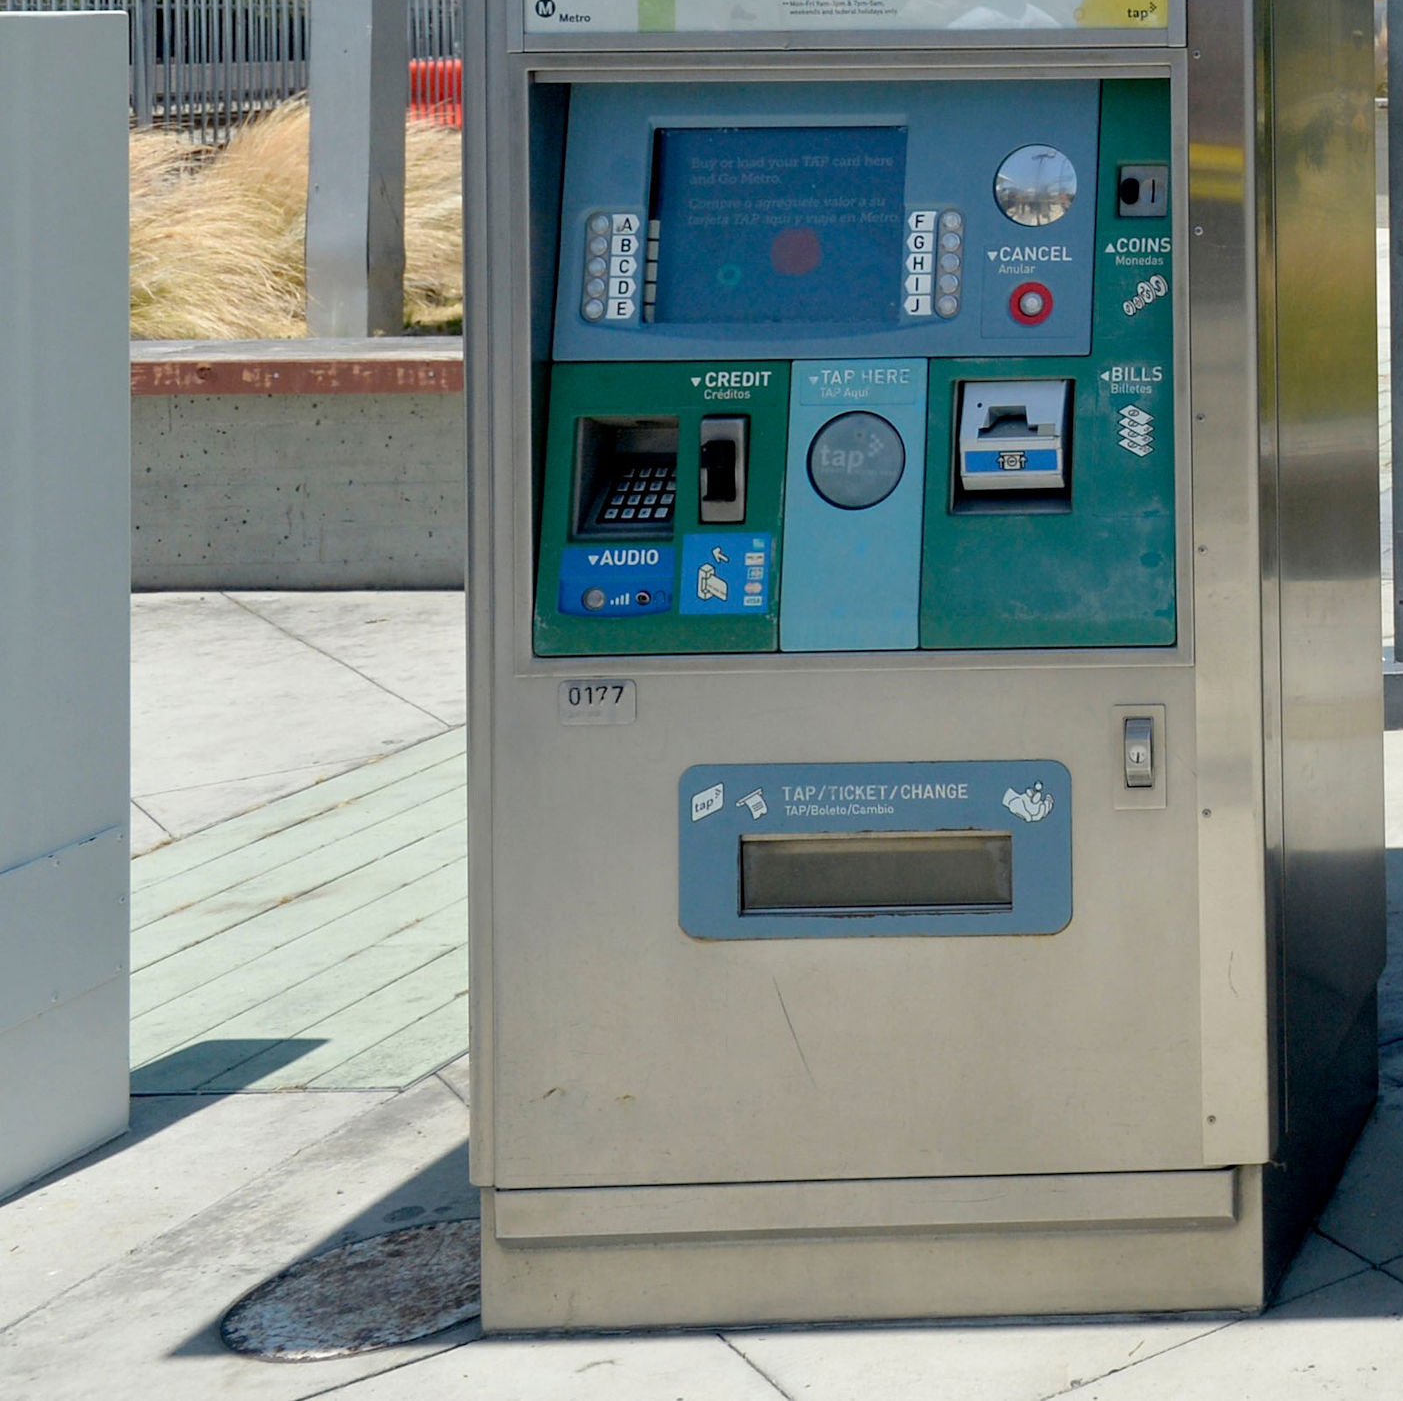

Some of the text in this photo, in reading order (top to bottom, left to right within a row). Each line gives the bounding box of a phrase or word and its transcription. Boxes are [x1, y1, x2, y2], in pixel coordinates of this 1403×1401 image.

[558, 14, 590, 23] Metro
[1127, 8, 1150, 21] tap
[1116, 237, 1172, 253] COINS
[999, 246, 1073, 262] CANCEL
[1115, 254, 1164, 266] Monedas
[998, 264, 1036, 274] Anular
[704, 371, 772, 387] CREDIT
[821, 369, 855, 385] TAP
[1111, 367, 1163, 381] BILLS
[703, 388, 751, 400] Créditos
[1110, 383, 1153, 394] Billetes
[820, 444, 865, 469] tap
[600, 549, 660, 565] AUDIO
[567, 687, 625, 706] 0177
[781, 783, 970, 802] TAP/TICKET/CHANGE
[693, 795, 716, 816] tap
[784, 805, 895, 816] TAP/Boleto/Cambio
